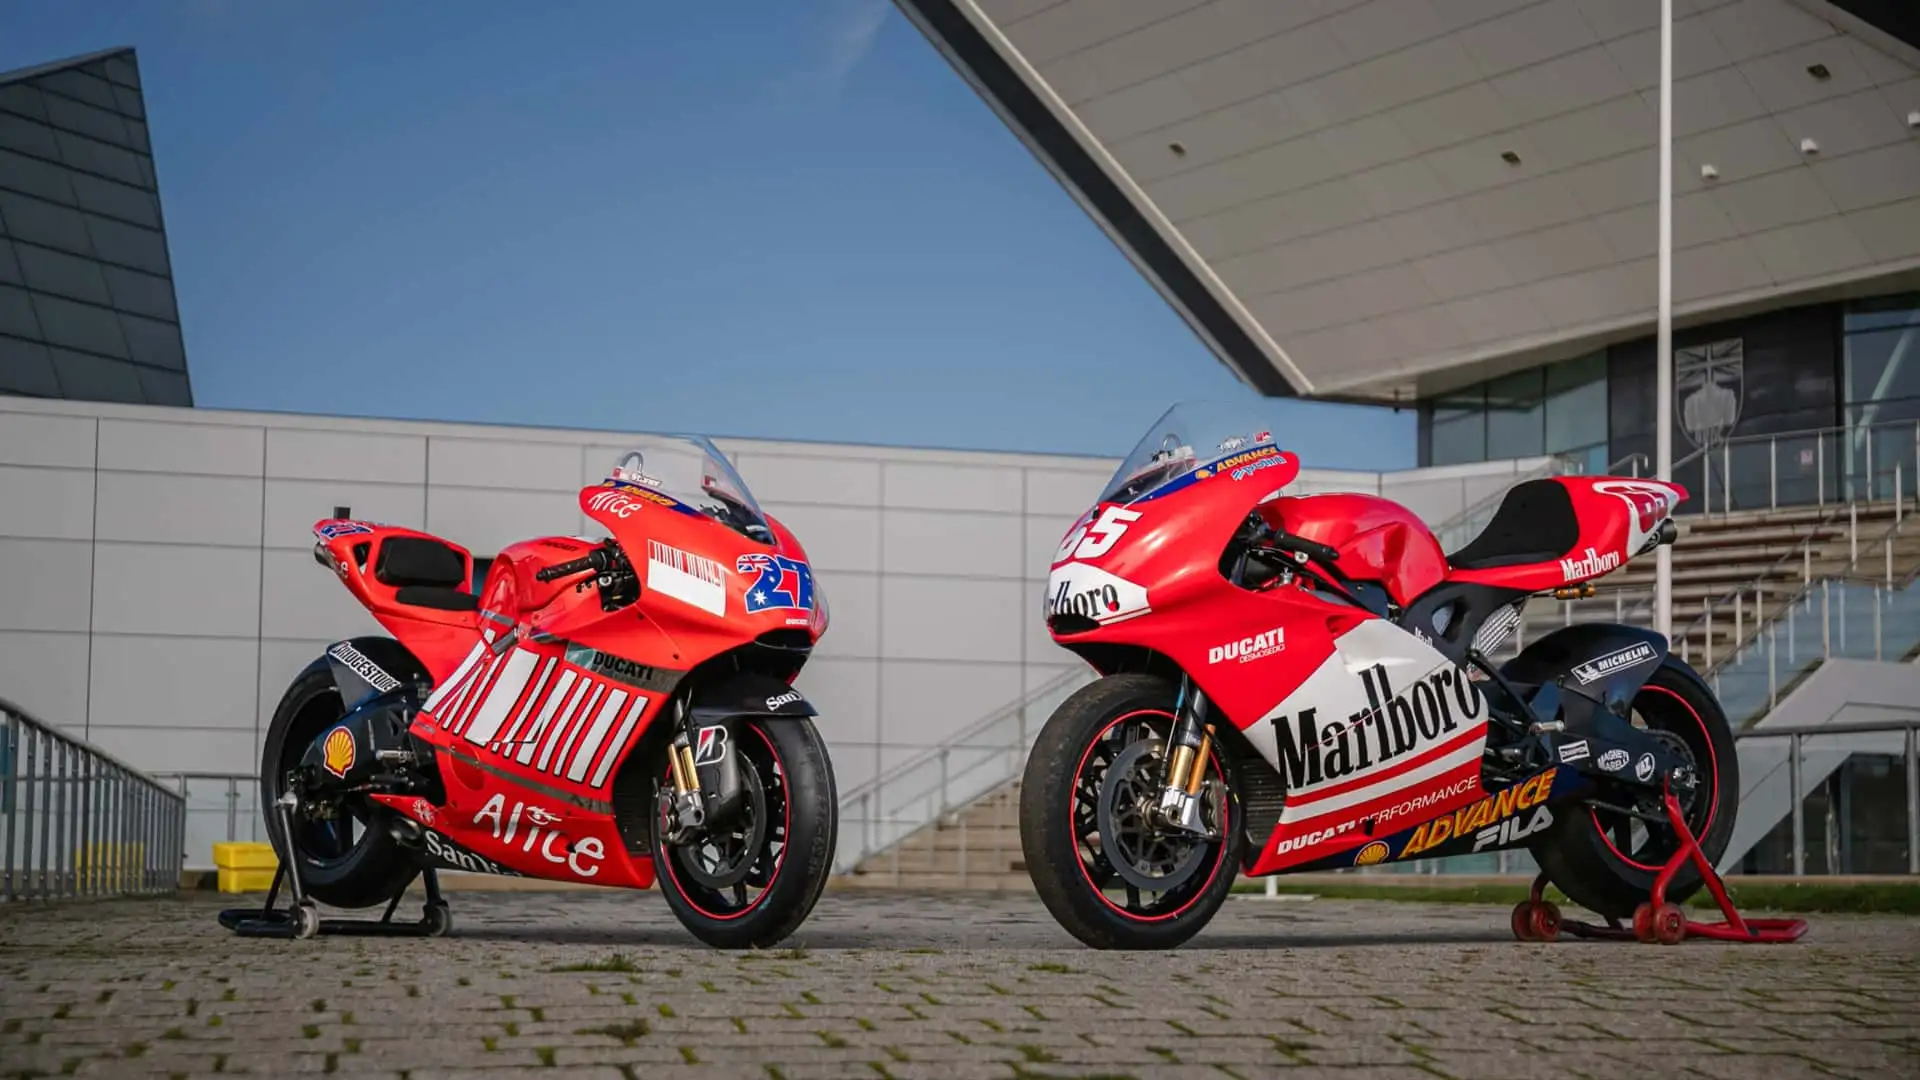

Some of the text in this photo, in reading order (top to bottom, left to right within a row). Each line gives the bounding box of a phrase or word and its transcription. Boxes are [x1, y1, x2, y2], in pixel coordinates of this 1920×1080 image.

[1217, 447, 1278, 472] ADVANCE
[736, 553, 813, 614] 27
[1560, 547, 1620, 581] Marlboro
[331, 641, 400, 691] BRIDGESTONE
[593, 651, 653, 681] DUCATI
[1209, 626, 1284, 664] DUCATI
[1598, 645, 1650, 671] MICHELIN
[1271, 662, 1481, 790] Marlboro
[1398, 766, 1558, 859] ADVANCE
[1472, 805, 1554, 852] FILA
[473, 793, 605, 877] Alice
[1277, 820, 1356, 855] DUCATI
